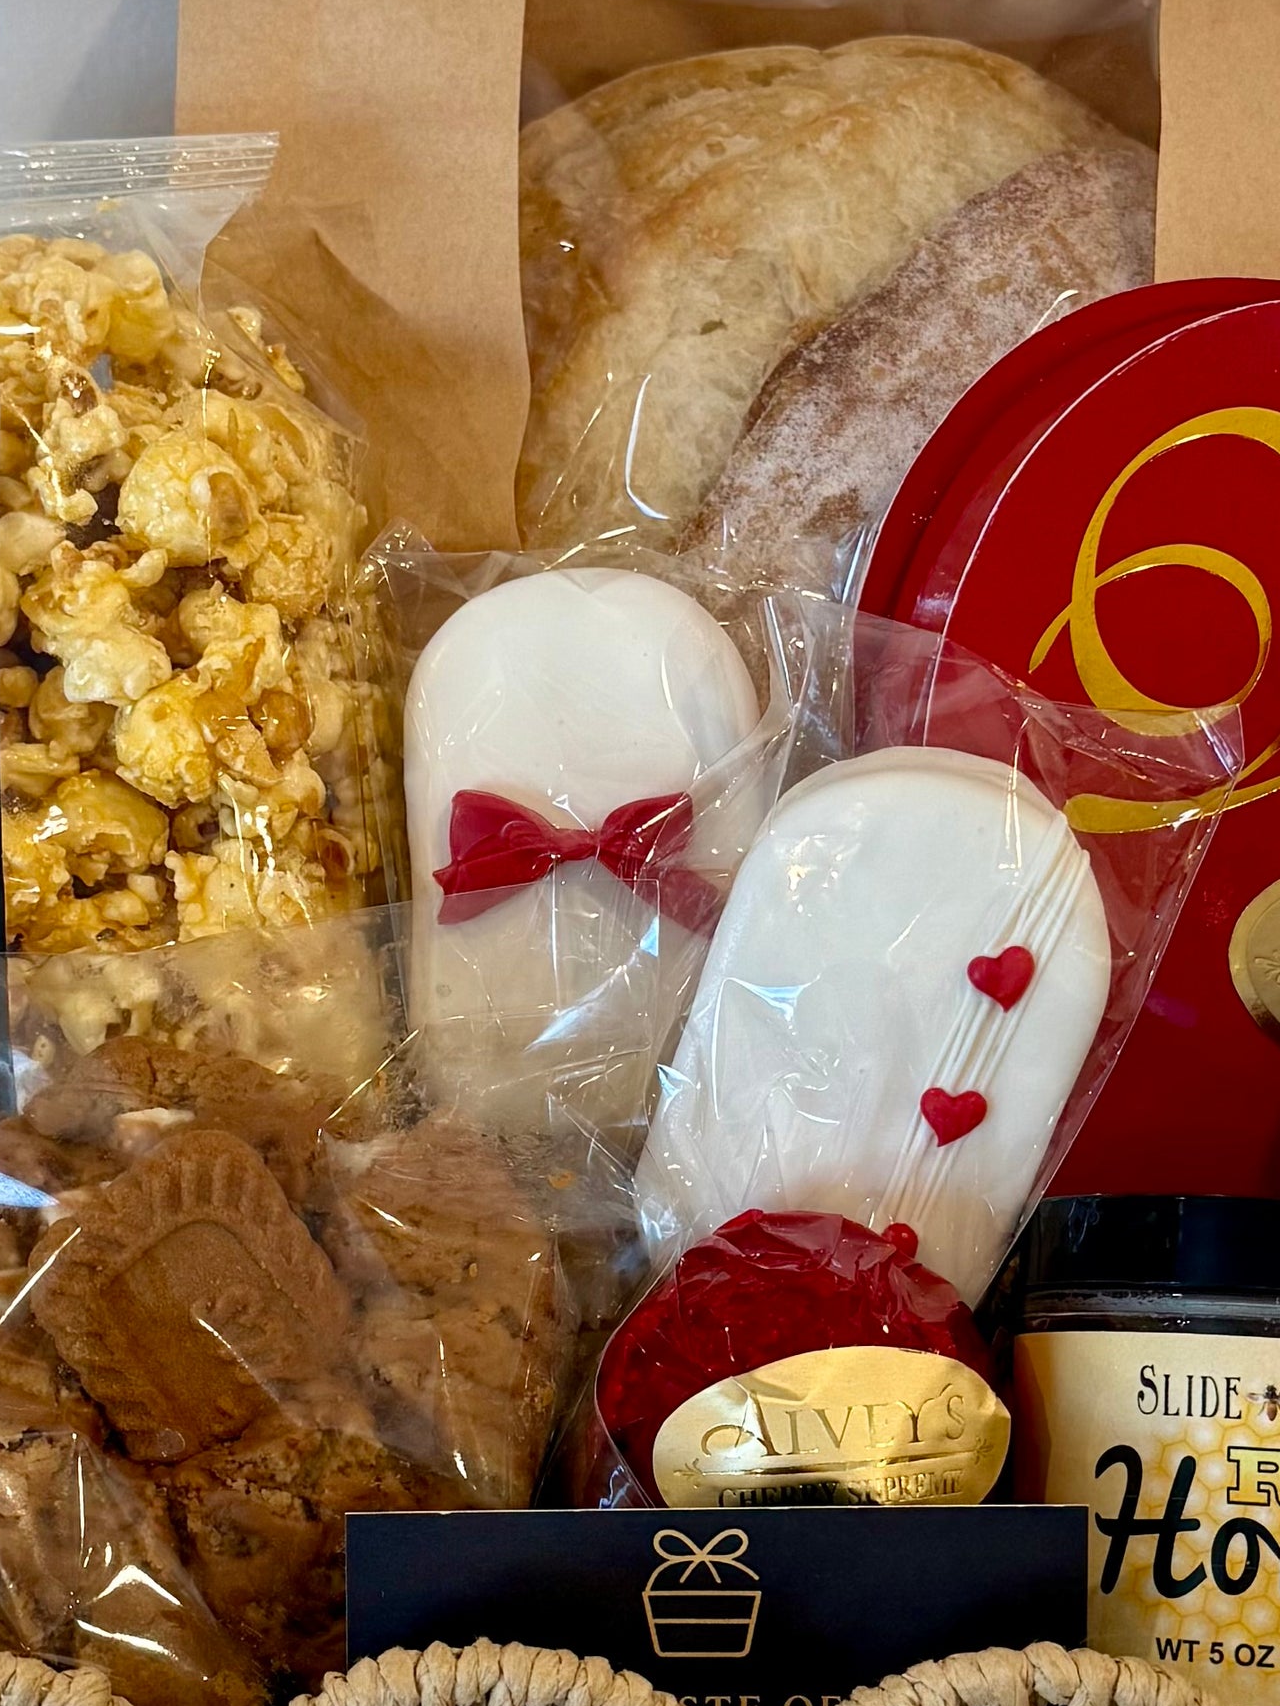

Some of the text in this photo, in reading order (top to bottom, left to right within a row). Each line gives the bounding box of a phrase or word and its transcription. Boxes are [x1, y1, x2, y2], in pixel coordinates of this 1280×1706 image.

[1137, 1364, 1243, 1420] SLIDE
[700, 1383, 966, 1460] ALVEY'S
[1155, 1637, 1200, 1663] WT
[1209, 1642, 1225, 1665] 5
[1234, 1643, 1276, 1669] OZ
